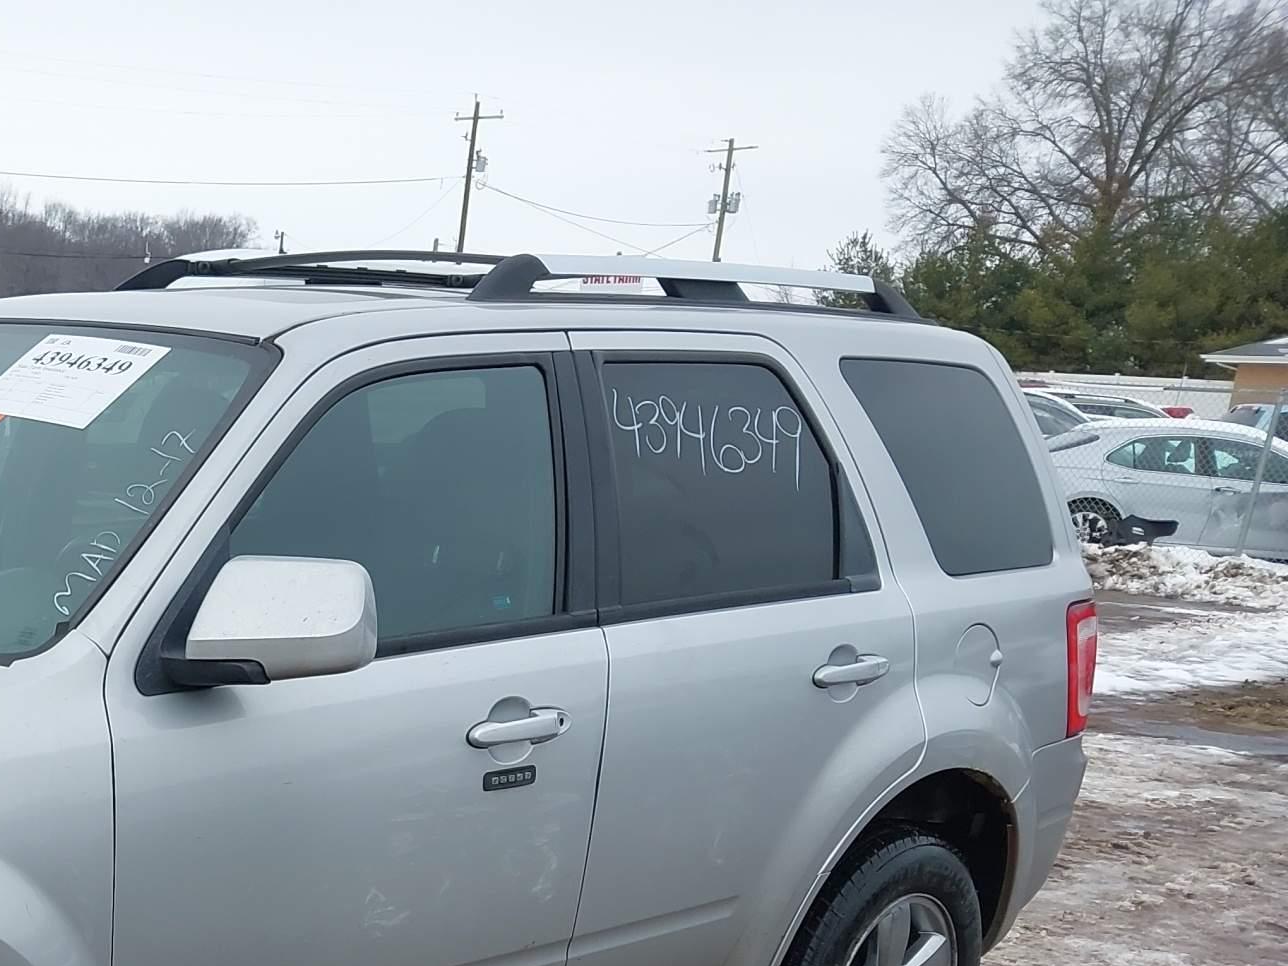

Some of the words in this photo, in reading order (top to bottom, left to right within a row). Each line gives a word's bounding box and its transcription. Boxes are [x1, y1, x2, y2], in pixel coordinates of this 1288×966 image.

[30, 351, 134, 375] 43946349
[612, 388, 802, 491] 43946349
[54, 531, 122, 616] MAD
[114, 428, 197, 516] 12-17
